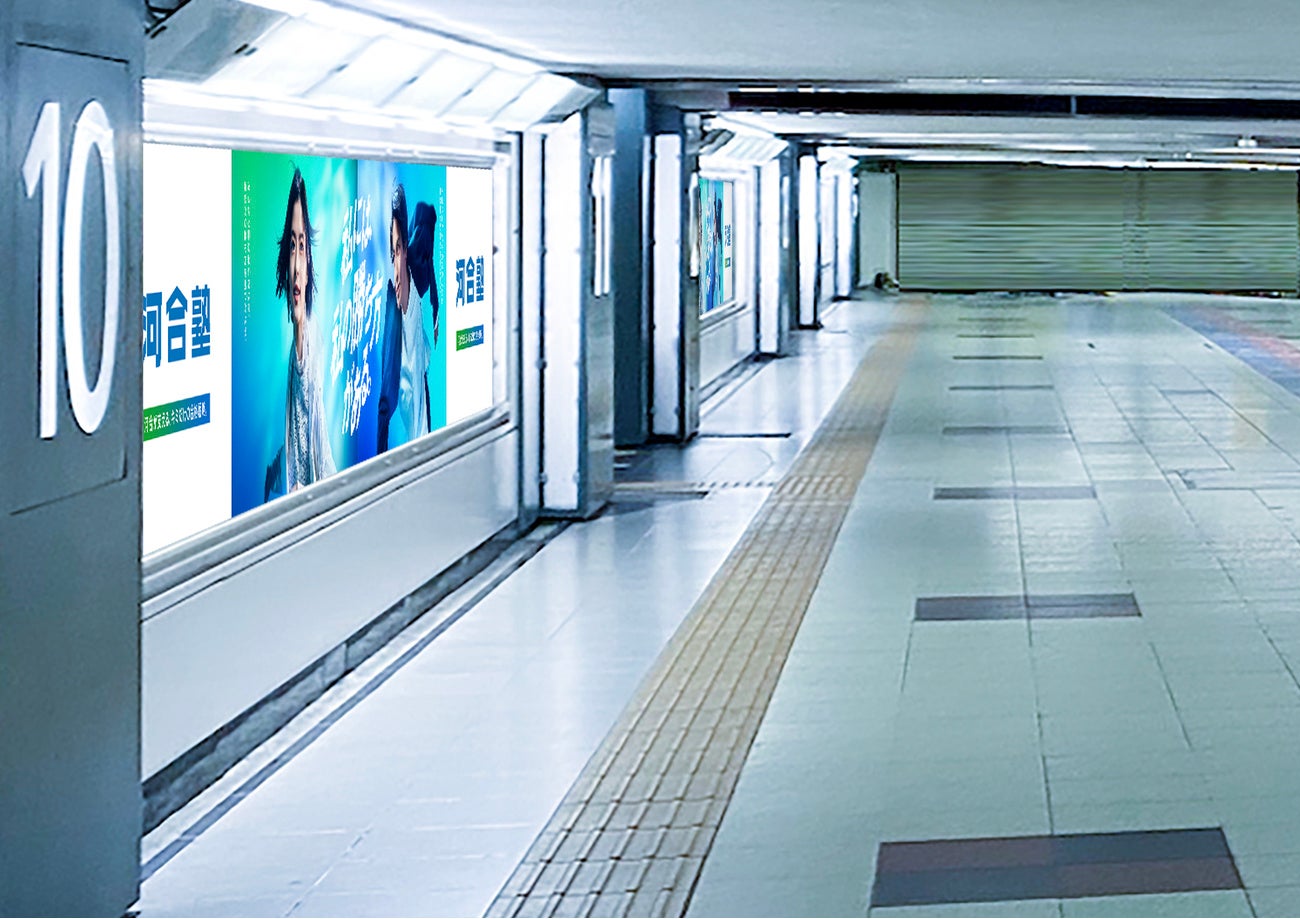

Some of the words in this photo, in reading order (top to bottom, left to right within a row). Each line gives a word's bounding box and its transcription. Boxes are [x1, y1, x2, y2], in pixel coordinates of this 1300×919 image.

[22, 99, 121, 440] 10
[456, 255, 485, 308] 河合塾
